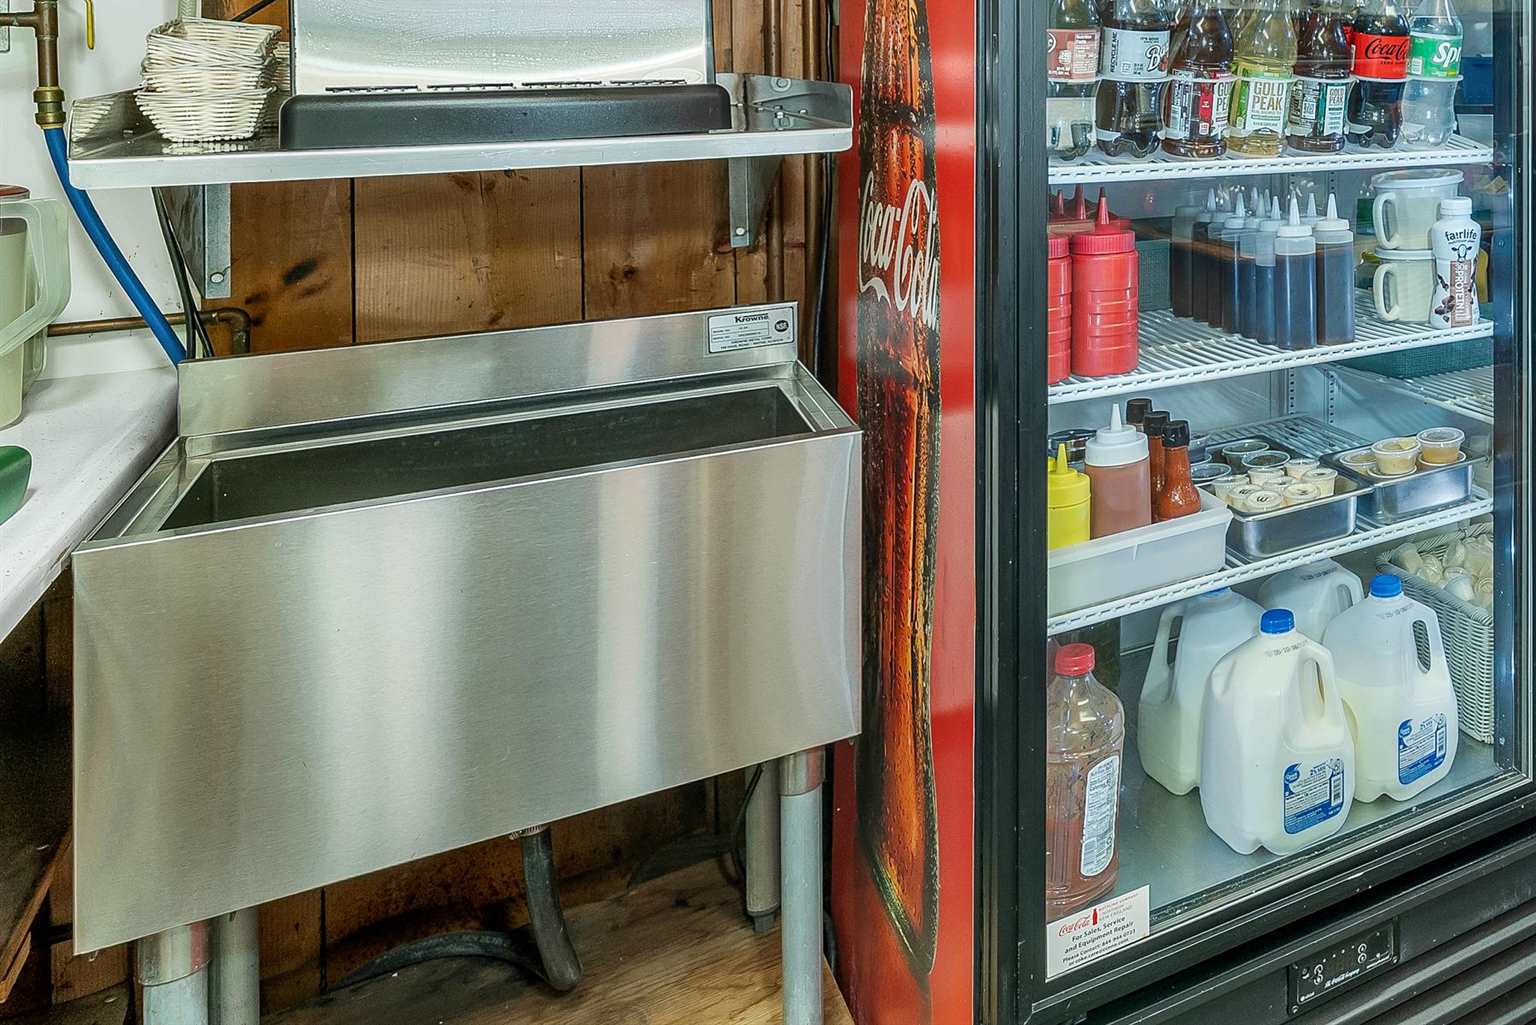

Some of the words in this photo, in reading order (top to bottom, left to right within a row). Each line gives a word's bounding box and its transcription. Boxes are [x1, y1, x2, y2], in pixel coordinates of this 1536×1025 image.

[1253, 81, 1285, 96] GOLD
[1329, 87, 1345, 96] GOLD
[1252, 95, 1283, 111] PEAK
[1329, 95, 1344, 104] PEAK
[1444, 228, 1478, 242] fairlife
[1456, 270, 1465, 310] PROTEIN
[734, 312, 769, 324] Krowne
[1058, 915, 1091, 937] Coca-Cola
[1071, 933, 1083, 943] For
[1102, 916, 1126, 930] Service
[1064, 944, 1078, 955] and
[1078, 930, 1113, 949] Equipment
[1113, 920, 1134, 935] Repair
